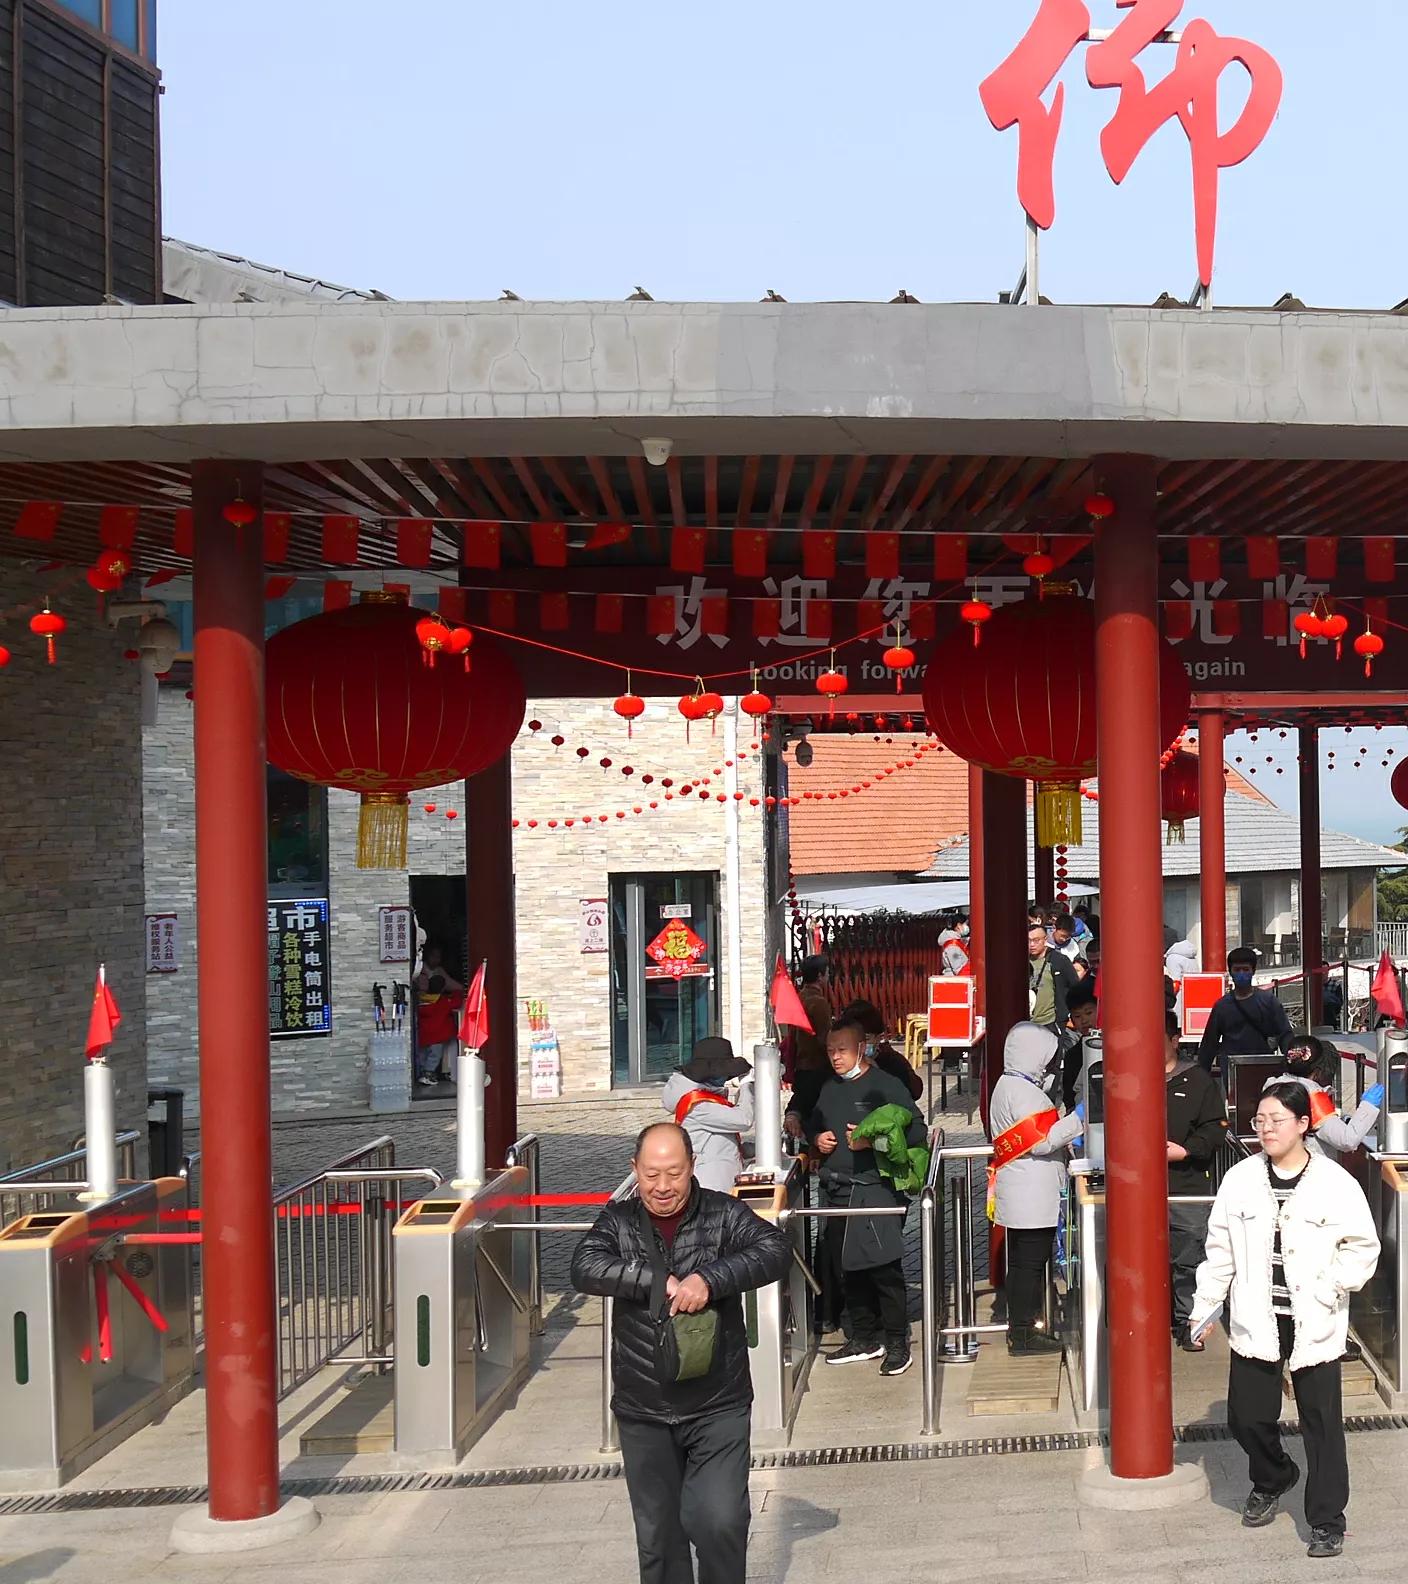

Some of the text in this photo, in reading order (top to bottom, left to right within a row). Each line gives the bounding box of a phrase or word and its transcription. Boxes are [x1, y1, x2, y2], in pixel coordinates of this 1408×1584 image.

[282, 931, 304, 1028] 各种雪糕冷饮
[302, 930, 323, 1027] 手电筒出租
